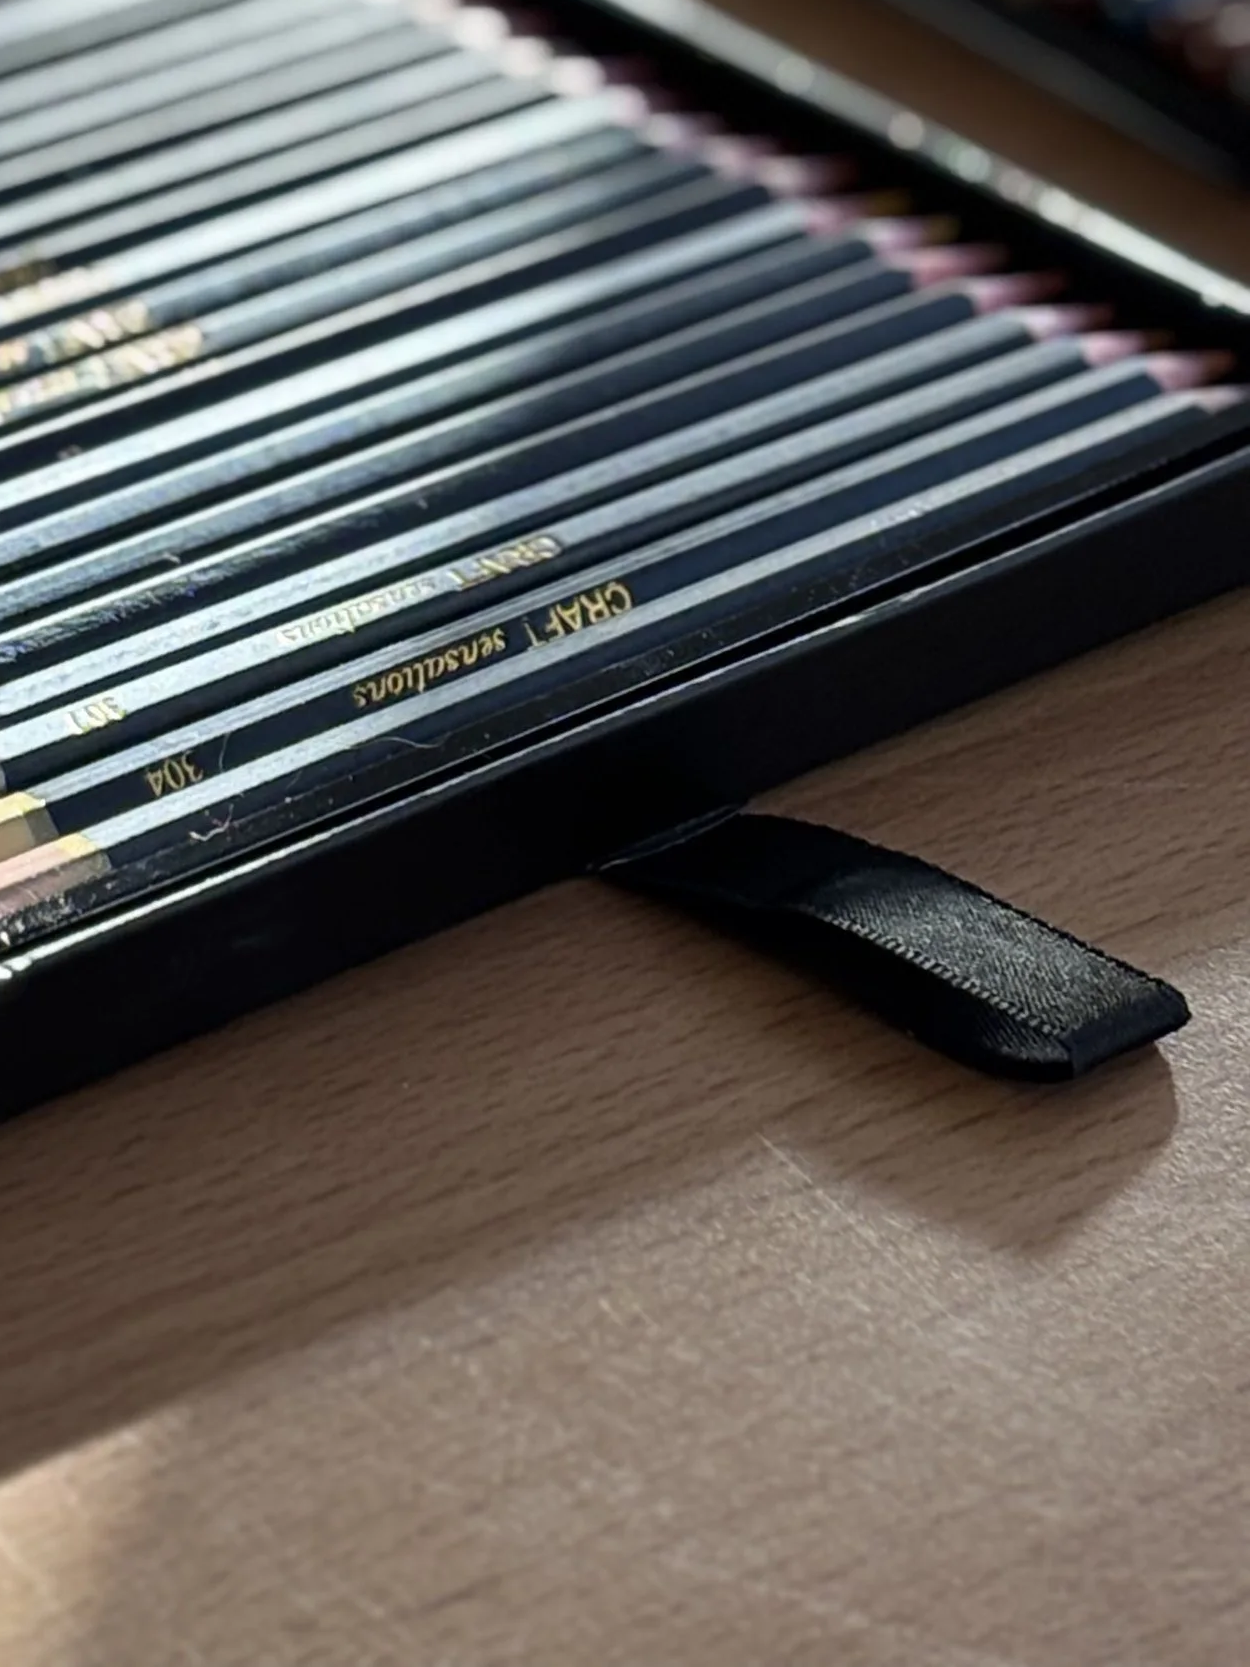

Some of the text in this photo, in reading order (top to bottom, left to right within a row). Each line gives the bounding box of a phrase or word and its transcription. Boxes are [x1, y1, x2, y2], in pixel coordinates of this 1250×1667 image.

[447, 535, 561, 591] CRAFT
[144, 581, 634, 797] CRAFT sensations 304
